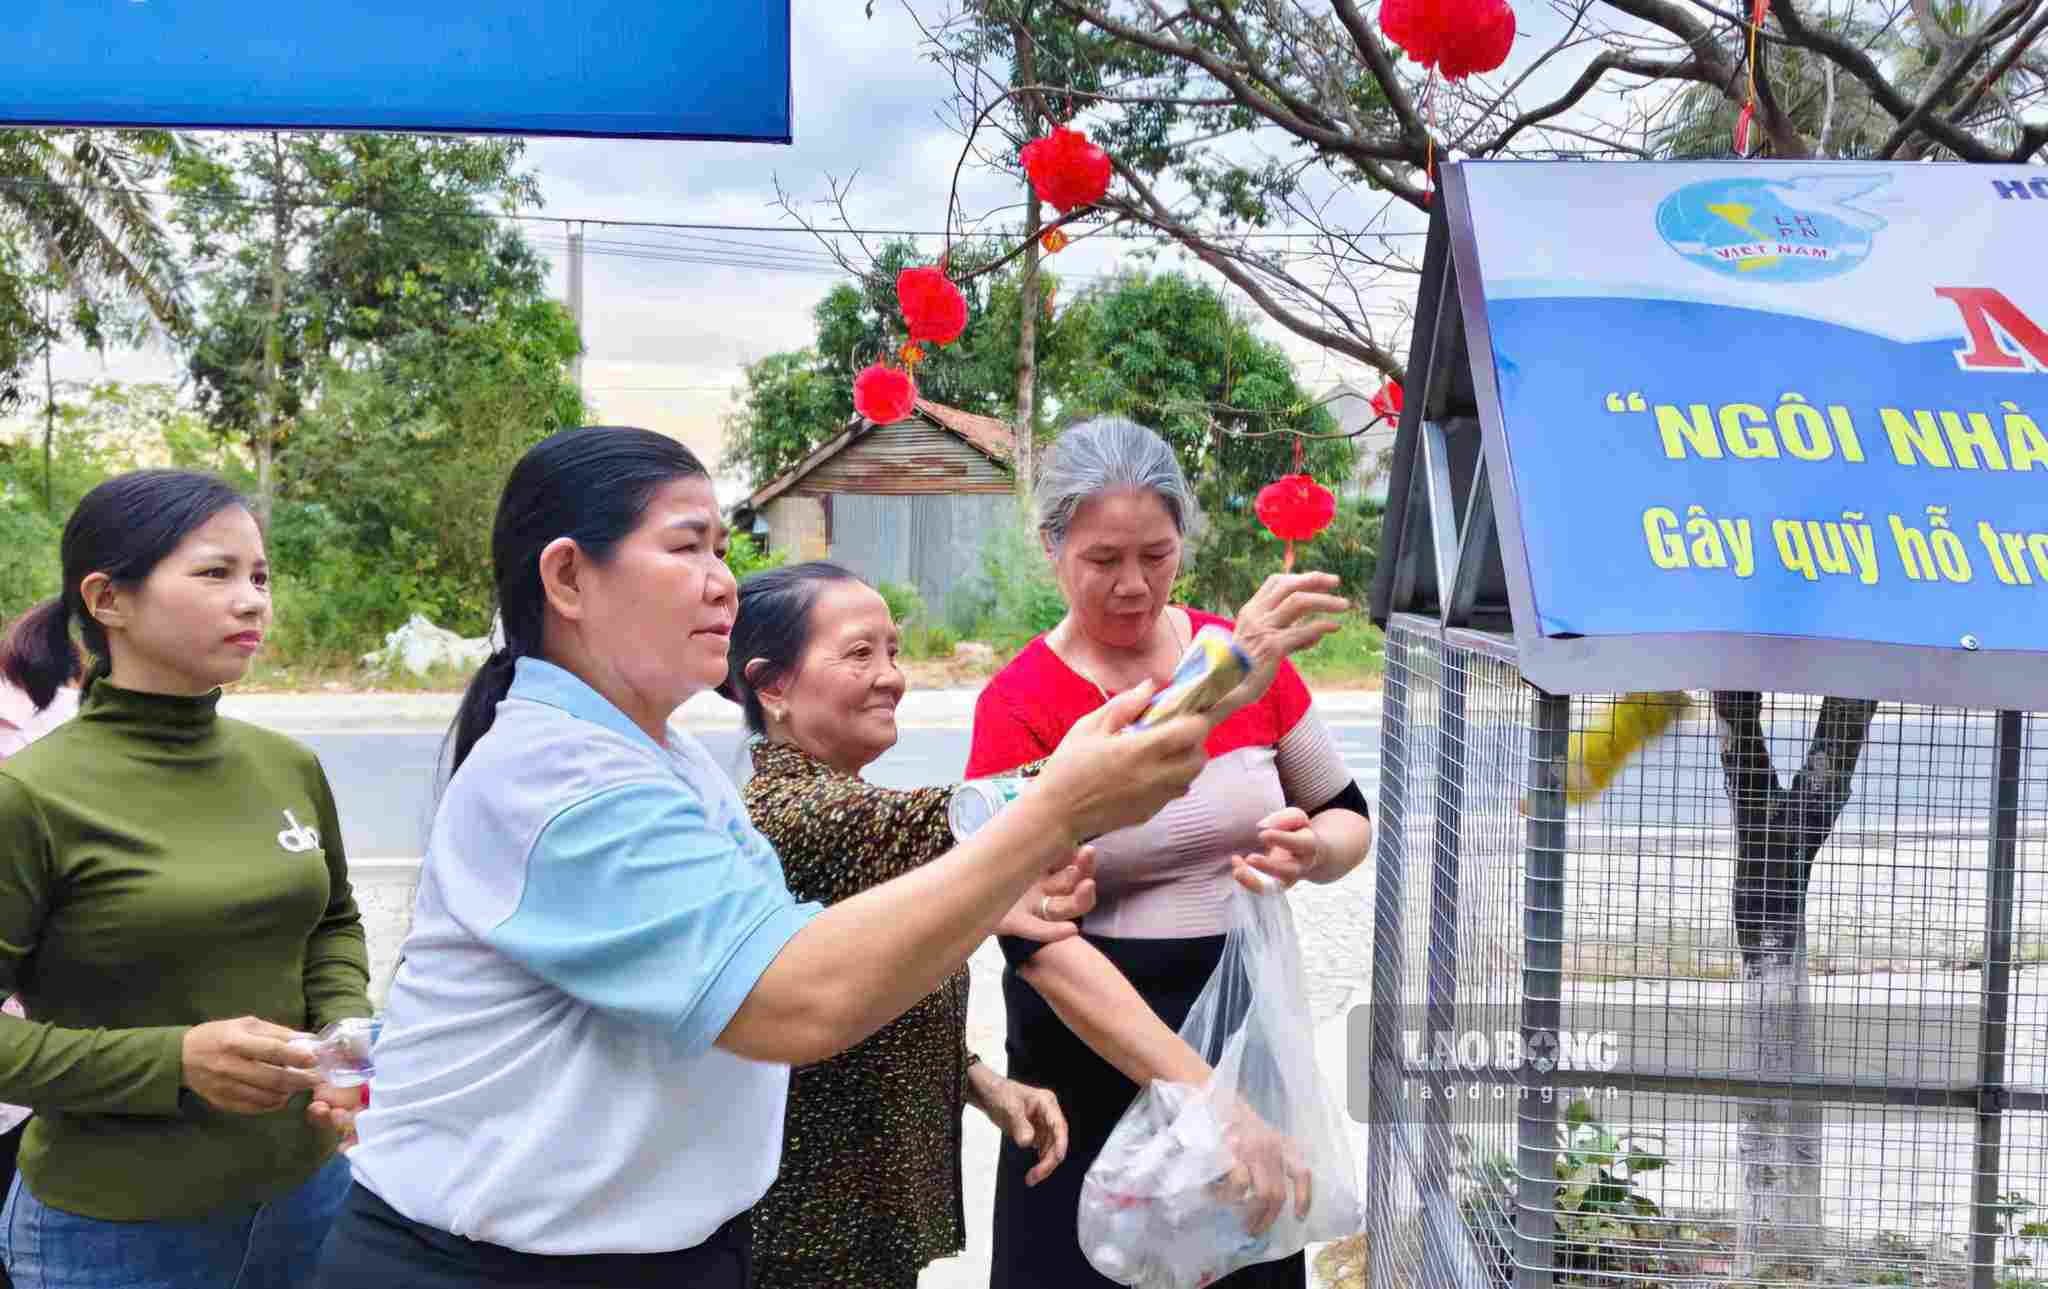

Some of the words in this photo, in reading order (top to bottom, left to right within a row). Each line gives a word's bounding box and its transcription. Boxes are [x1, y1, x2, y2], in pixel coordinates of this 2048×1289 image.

[1878, 400, 2048, 472] NHÀ
[1642, 504, 1755, 578] Gây
[1771, 510, 1880, 586] quỹ
[1887, 504, 1973, 584] hỗ
